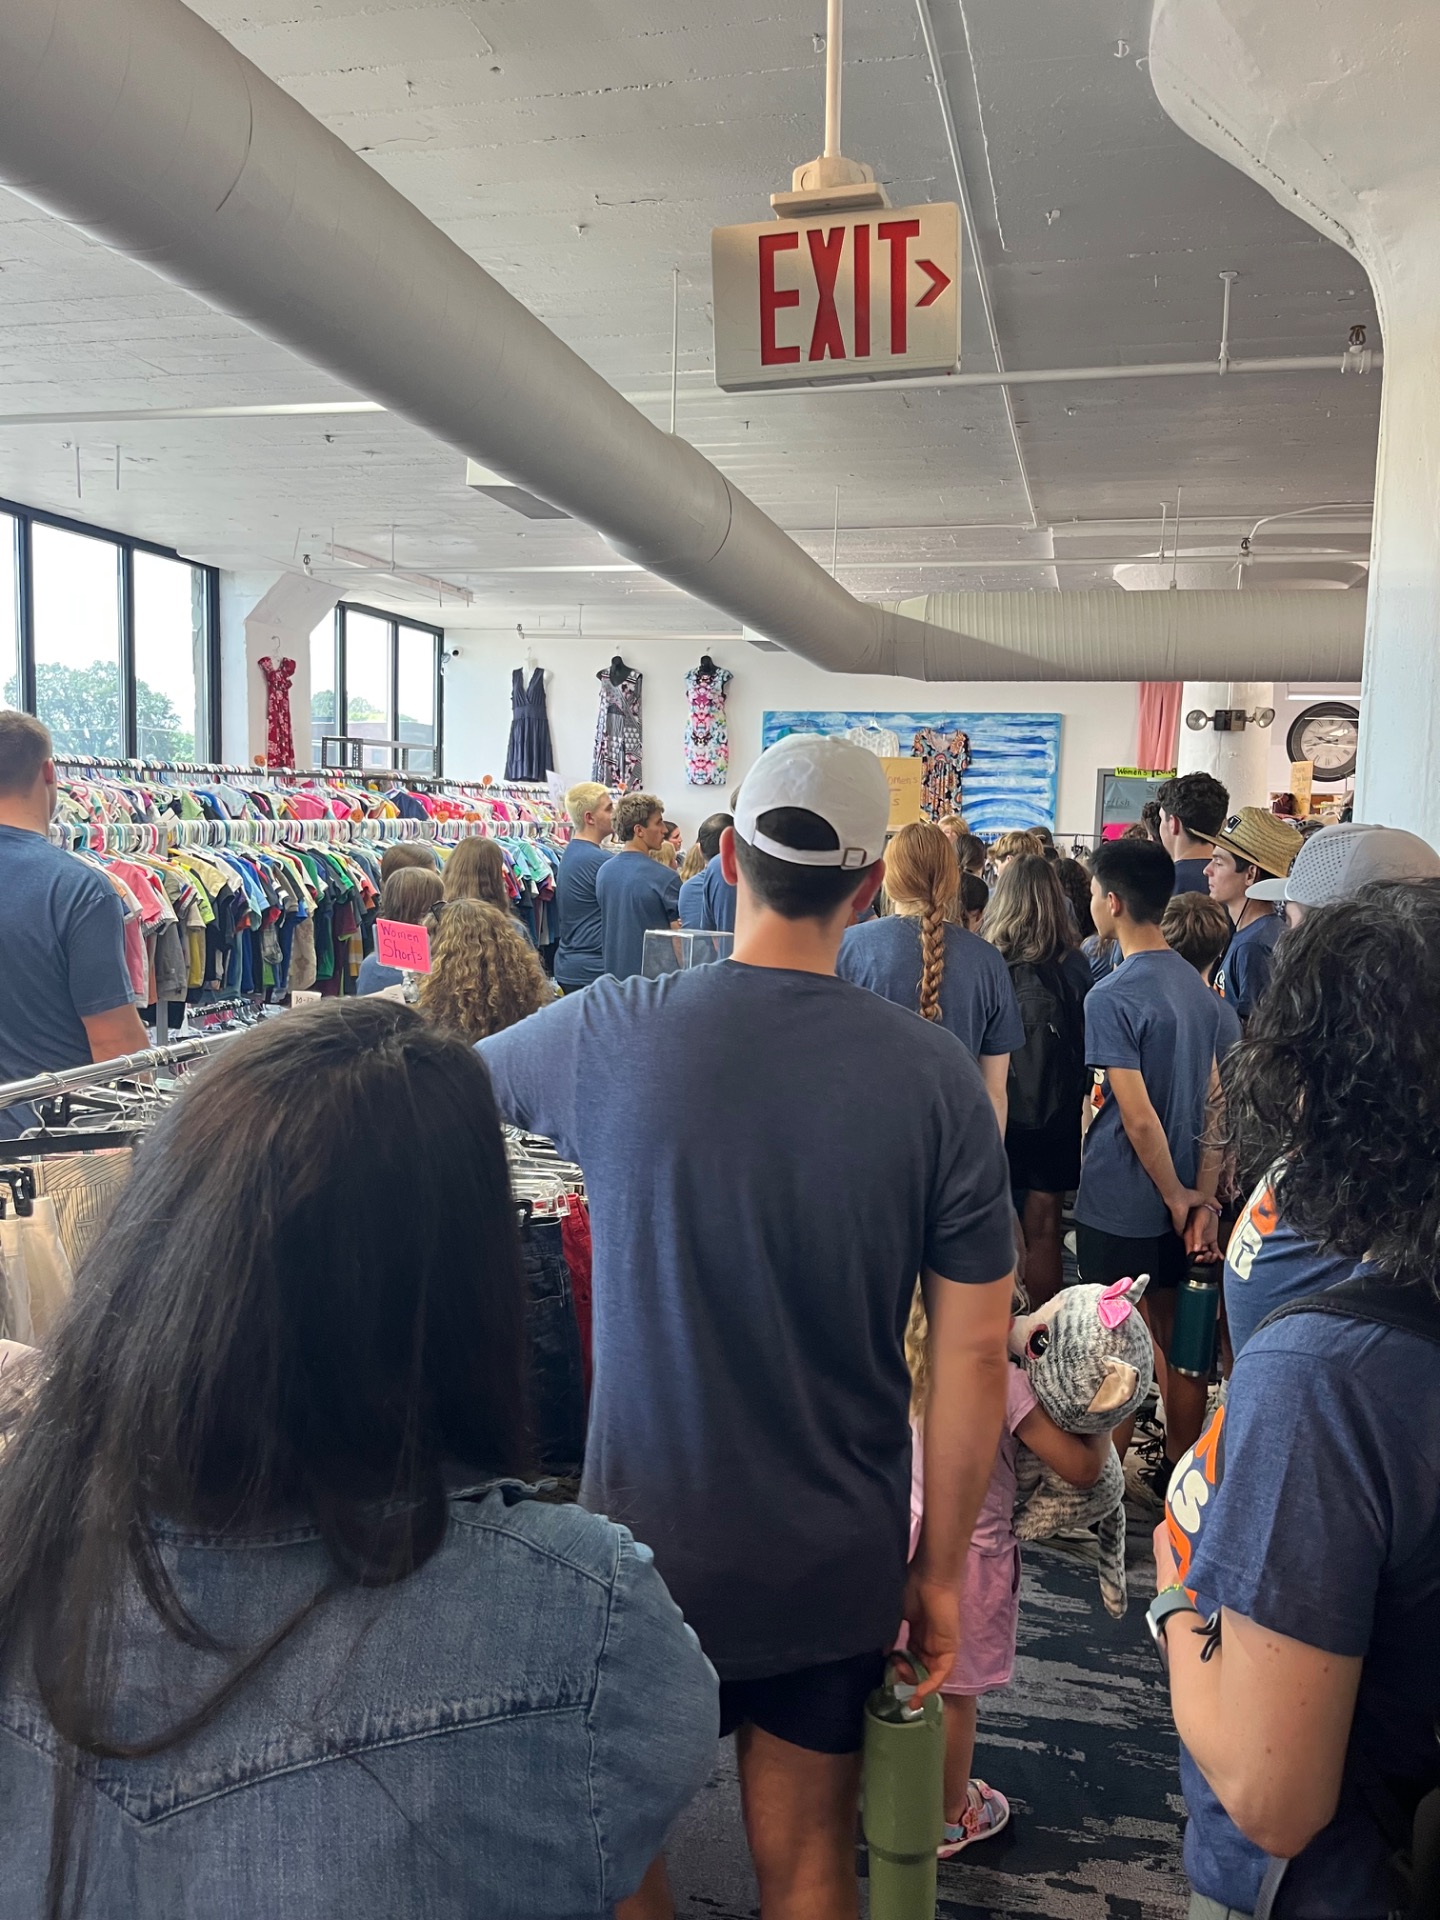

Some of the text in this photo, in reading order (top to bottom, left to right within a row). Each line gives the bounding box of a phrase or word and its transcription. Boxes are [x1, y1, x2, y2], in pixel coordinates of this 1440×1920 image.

[758, 218, 920, 366] EXIT
[380, 922, 420, 943] Women
[382, 938, 423, 964] Shorts
